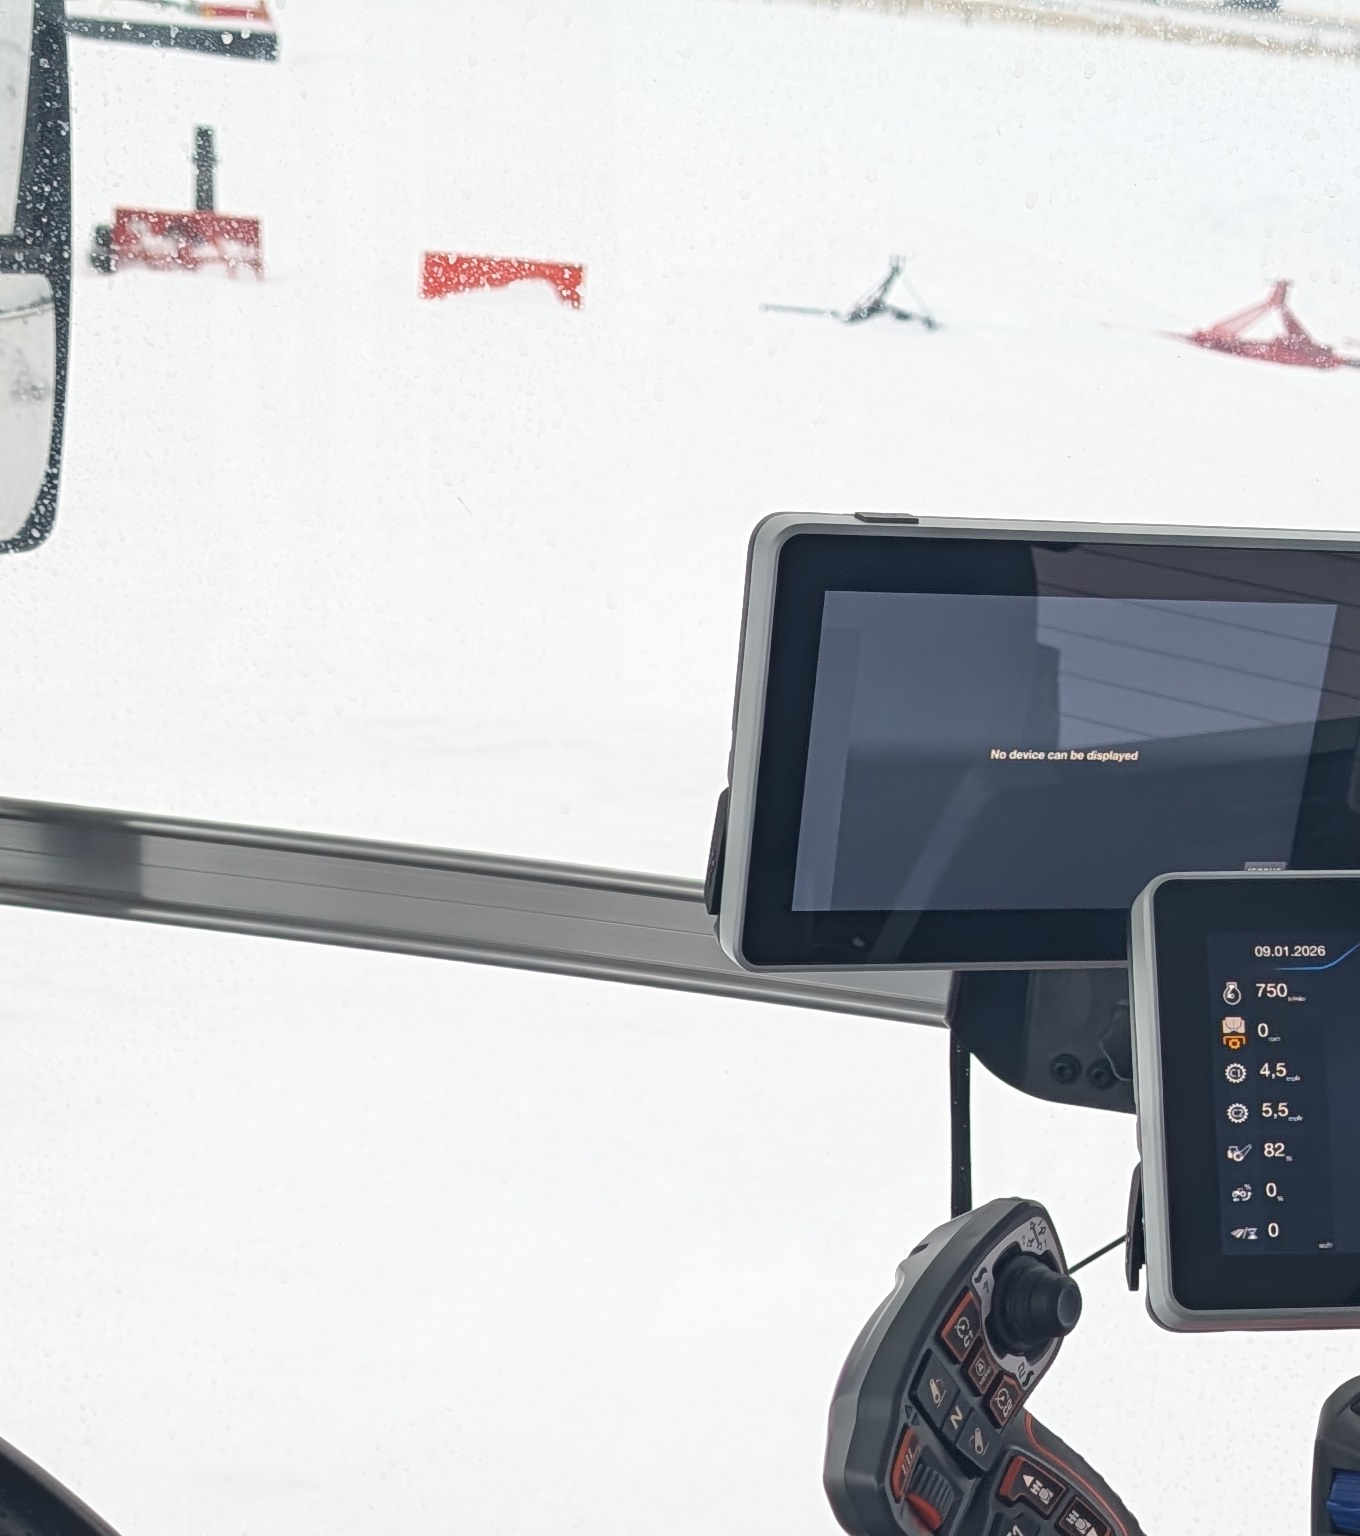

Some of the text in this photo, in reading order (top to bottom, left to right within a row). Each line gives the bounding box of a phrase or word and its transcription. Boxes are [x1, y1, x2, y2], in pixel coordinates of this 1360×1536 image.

[990, 749, 1139, 762] No device can be displayed
[1254, 945, 1327, 958] 09.01.2026
[1255, 982, 1288, 998] 750
[1257, 1022, 1269, 1038] 0
[1259, 1062, 1287, 1080] 4,5
[1261, 1102, 1289, 1120] 5,5
[1263, 1142, 1286, 1157] 82
[1265, 1182, 1277, 1198] 0
[1268, 1222, 1280, 1238] 0
[950, 1405, 964, 1430] N
